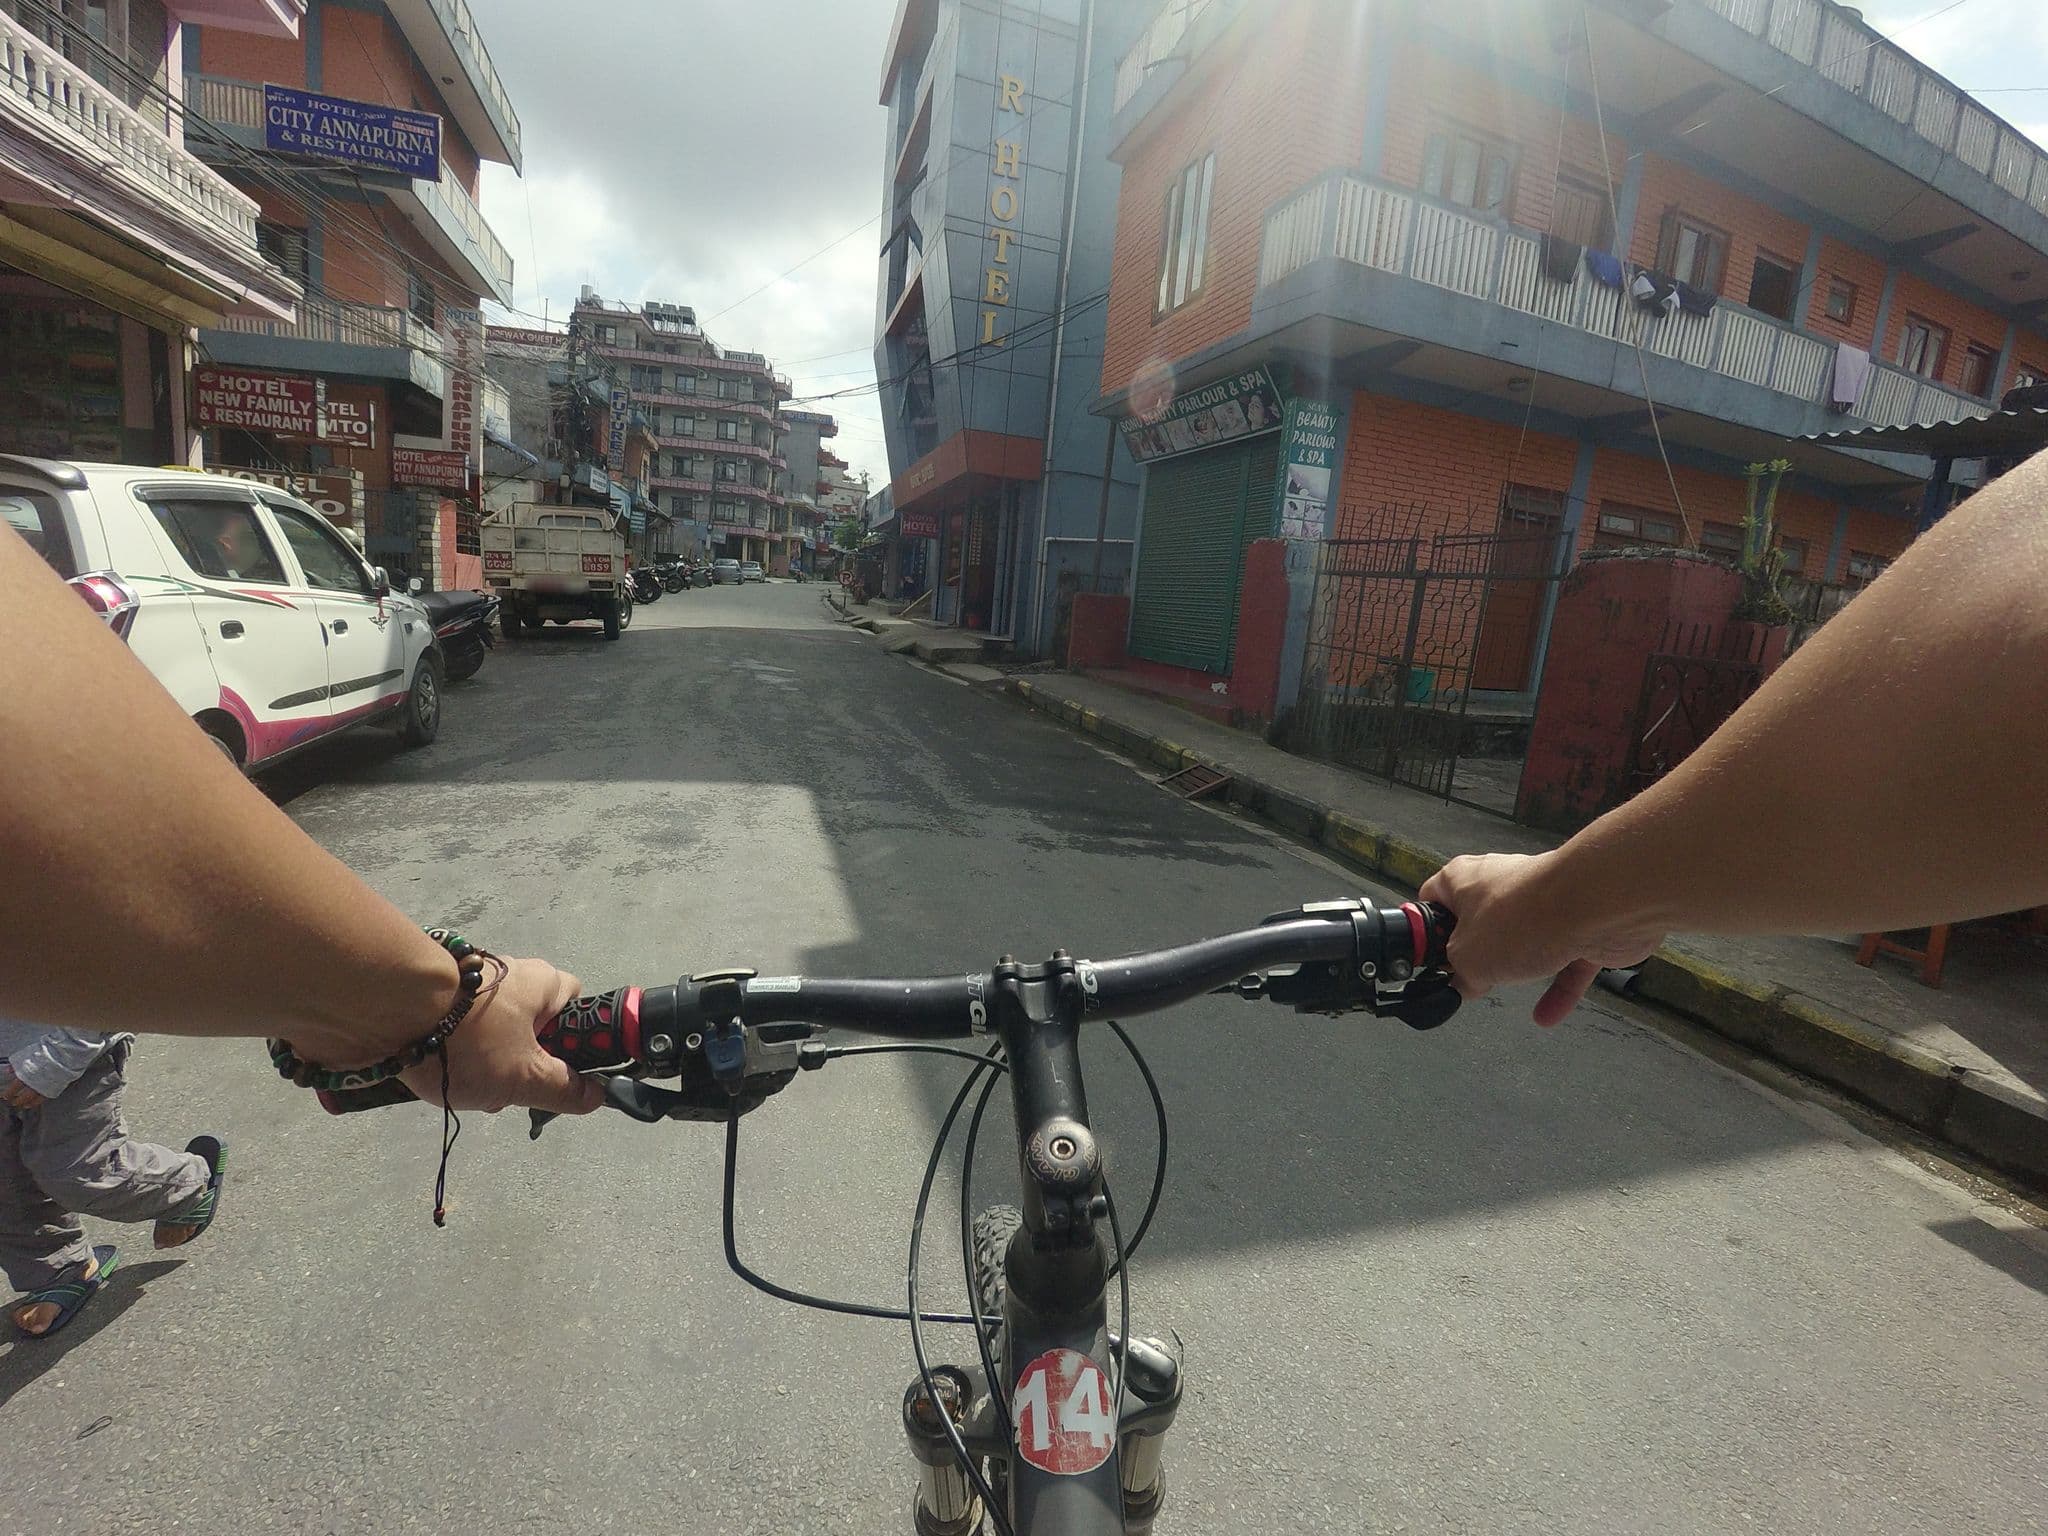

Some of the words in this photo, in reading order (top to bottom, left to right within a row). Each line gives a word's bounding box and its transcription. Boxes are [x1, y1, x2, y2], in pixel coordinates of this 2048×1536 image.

[1000, 75, 1025, 115] R
[307, 100, 360, 118] HOTEL
[268, 106, 316, 132] CITY
[320, 116, 434, 156] ANNAPURNA
[281, 129, 294, 142] &
[300, 133, 423, 167] RESTAURANT
[982, 137, 1021, 348] HOTEL
[526, 332, 554, 345] GUEST
[724, 350, 745, 361] HOTEL
[219, 374, 293, 397] HOTEL
[1178, 386, 1228, 413] PARLOUR
[1228, 381, 1239, 396] &
[1239, 370, 1266, 392] SPA
[200, 389, 241, 407] NEW
[246, 394, 312, 416] FAMILY
[327, 402, 359, 417] TEL
[200, 406, 210, 421] &
[215, 408, 312, 433] RESTAURANT
[1296, 411, 1337, 433] BEAUTY
[1292, 430, 1336, 449] PARLOUR
[393, 450, 427, 462] HOTEL
[1298, 448, 1306, 462] &
[1307, 450, 1325, 464] SPA
[394, 461, 414, 473] CITY
[414, 463, 464, 479] ANNAPURNA
[903, 520, 937, 534] HOTEL
[1014, 1366, 1114, 1452] 14
